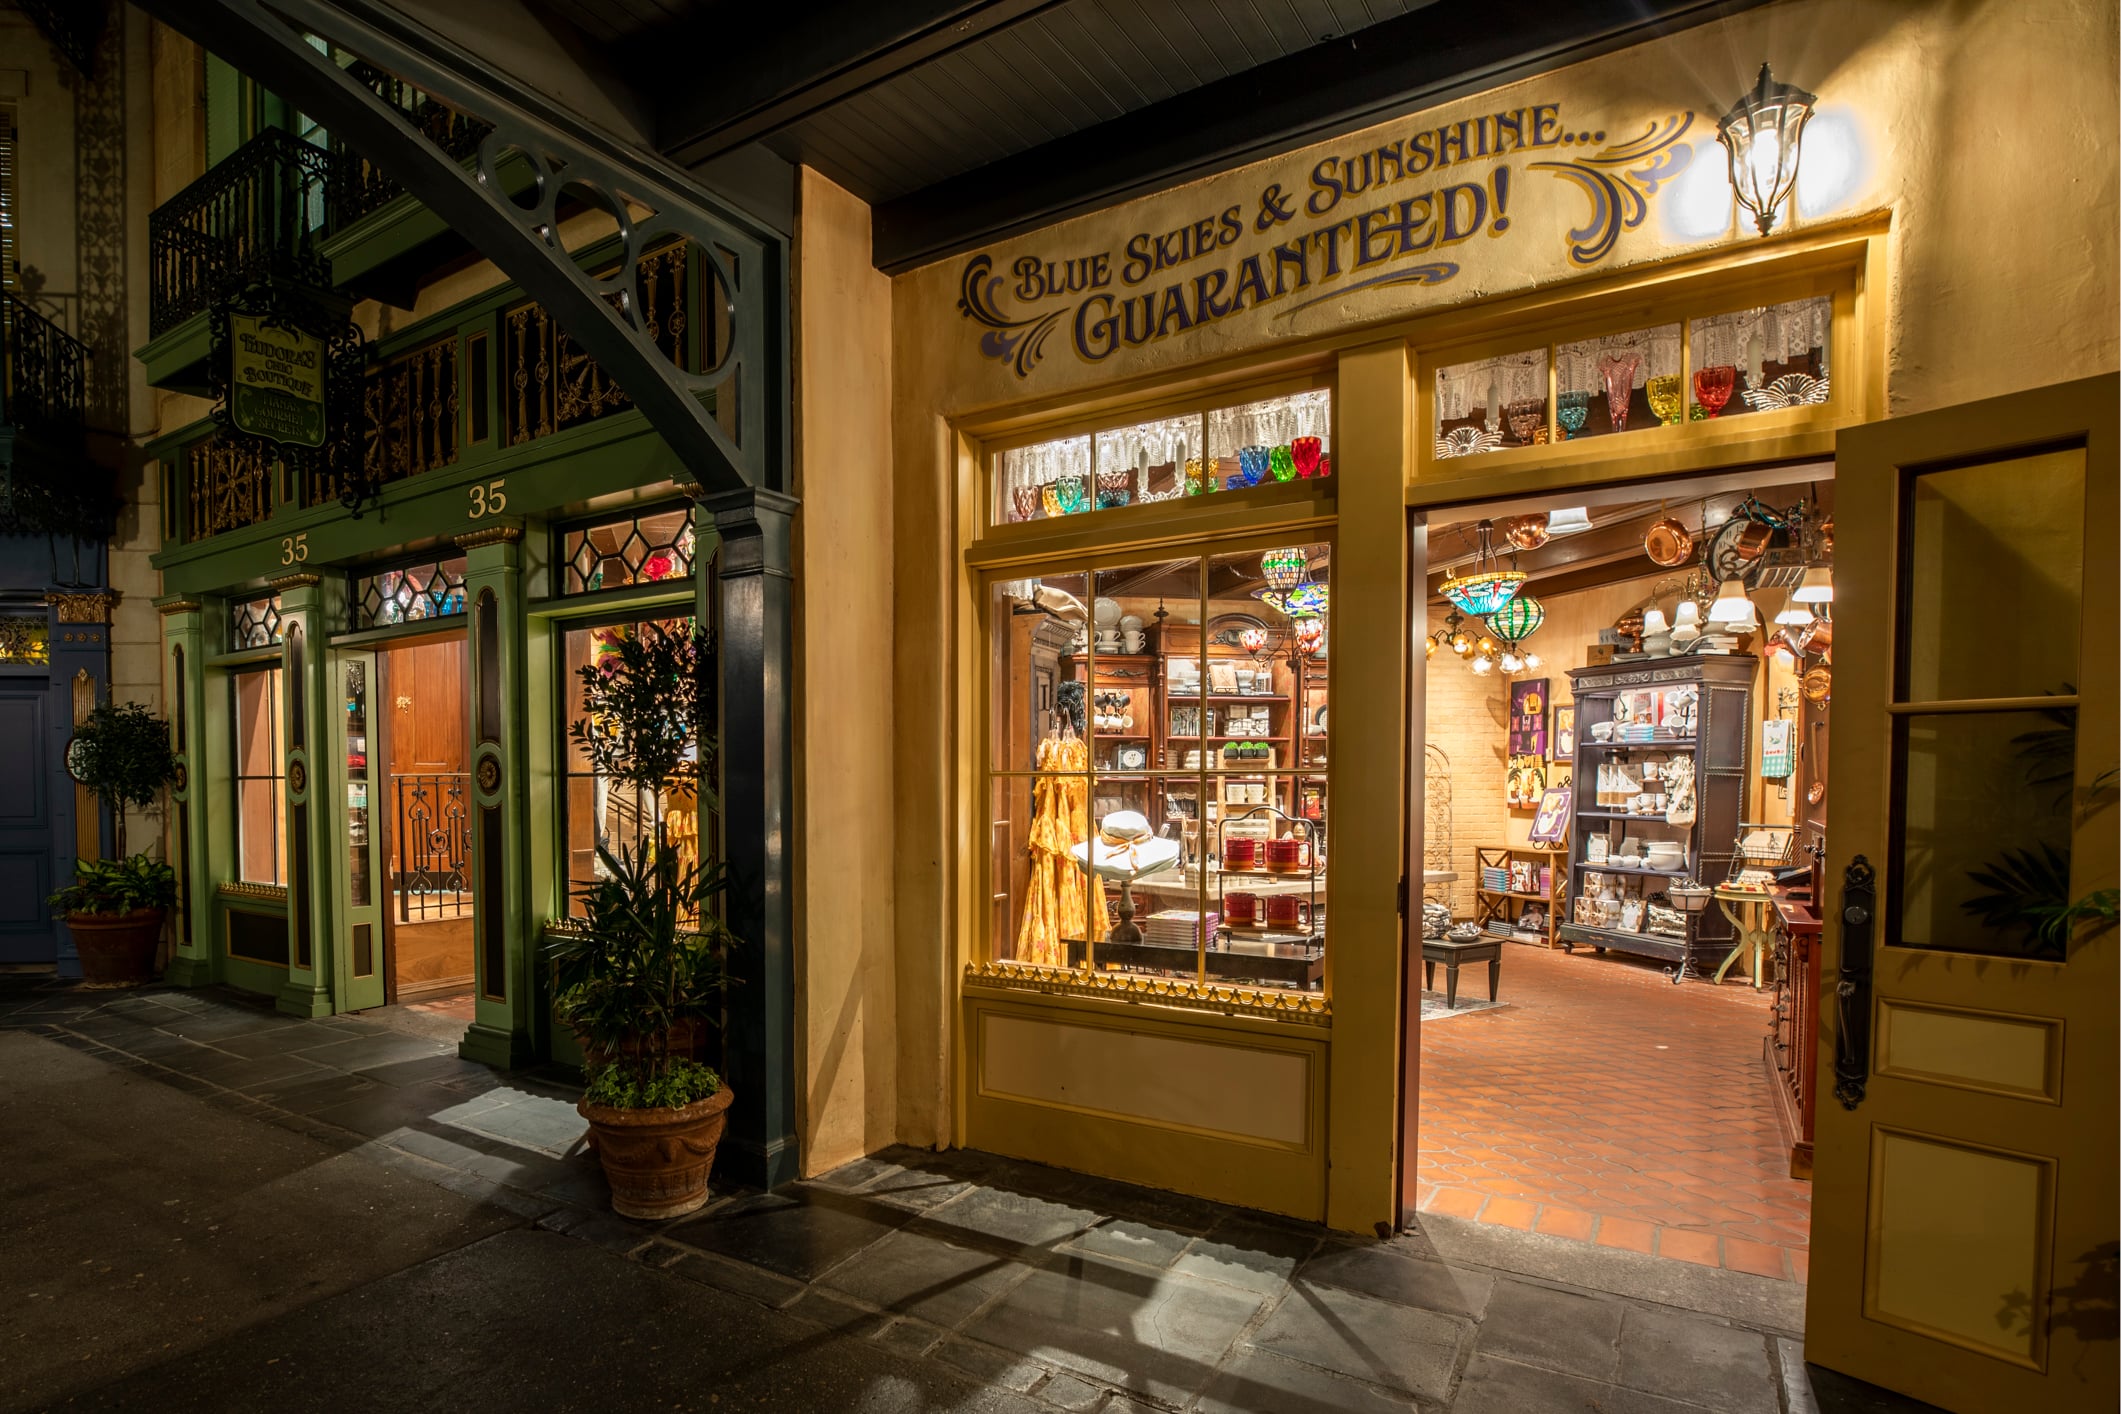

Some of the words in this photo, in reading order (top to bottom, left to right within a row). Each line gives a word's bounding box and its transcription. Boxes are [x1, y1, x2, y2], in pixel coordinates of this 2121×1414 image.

[1013, 253, 1112, 302] BLUE
[1122, 204, 1243, 286] SKIES
[1254, 182, 1297, 236] &
[1071, 164, 1513, 364] GUARANTEED!
[243, 367, 314, 397] BOUTIQUE
[265, 360, 293, 375] CHIC
[468, 479, 507, 519] 35
[281, 533, 309, 565] 35
